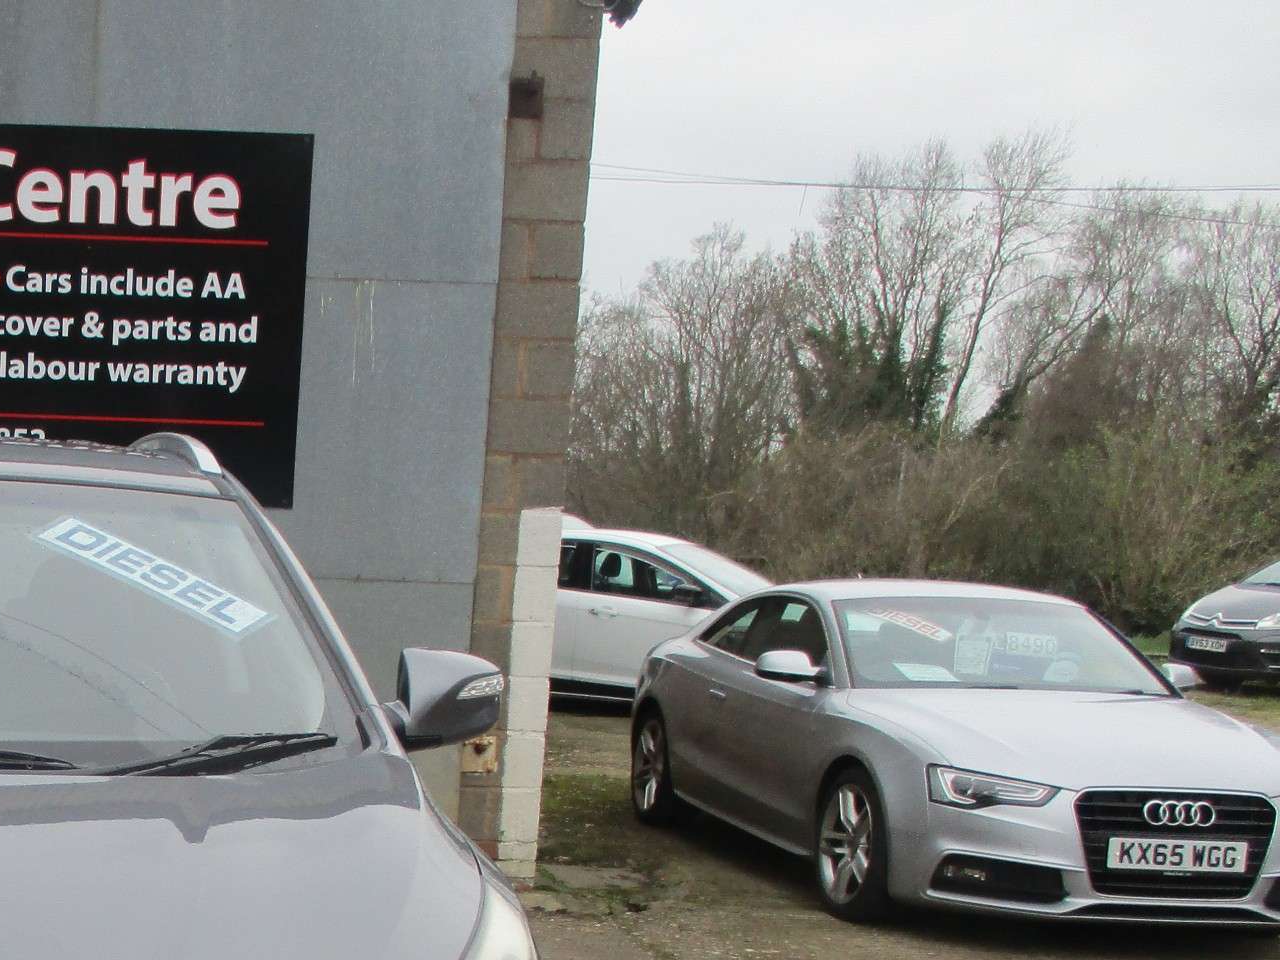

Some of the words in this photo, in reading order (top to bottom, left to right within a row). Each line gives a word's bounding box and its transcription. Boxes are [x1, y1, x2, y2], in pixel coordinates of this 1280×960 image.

[5, 264, 72, 293] Cars
[80, 267, 193, 298] include
[200, 271, 246, 300] AA
[81, 311, 104, 340] &
[112, 316, 192, 346] parts
[199, 316, 258, 344] and
[0, 351, 100, 381] labour
[107, 359, 247, 394] warranty
[55, 524, 239, 625] DIESEL
[1119, 842, 1184, 867] KX65
[1192, 844, 1237, 869] WGG
